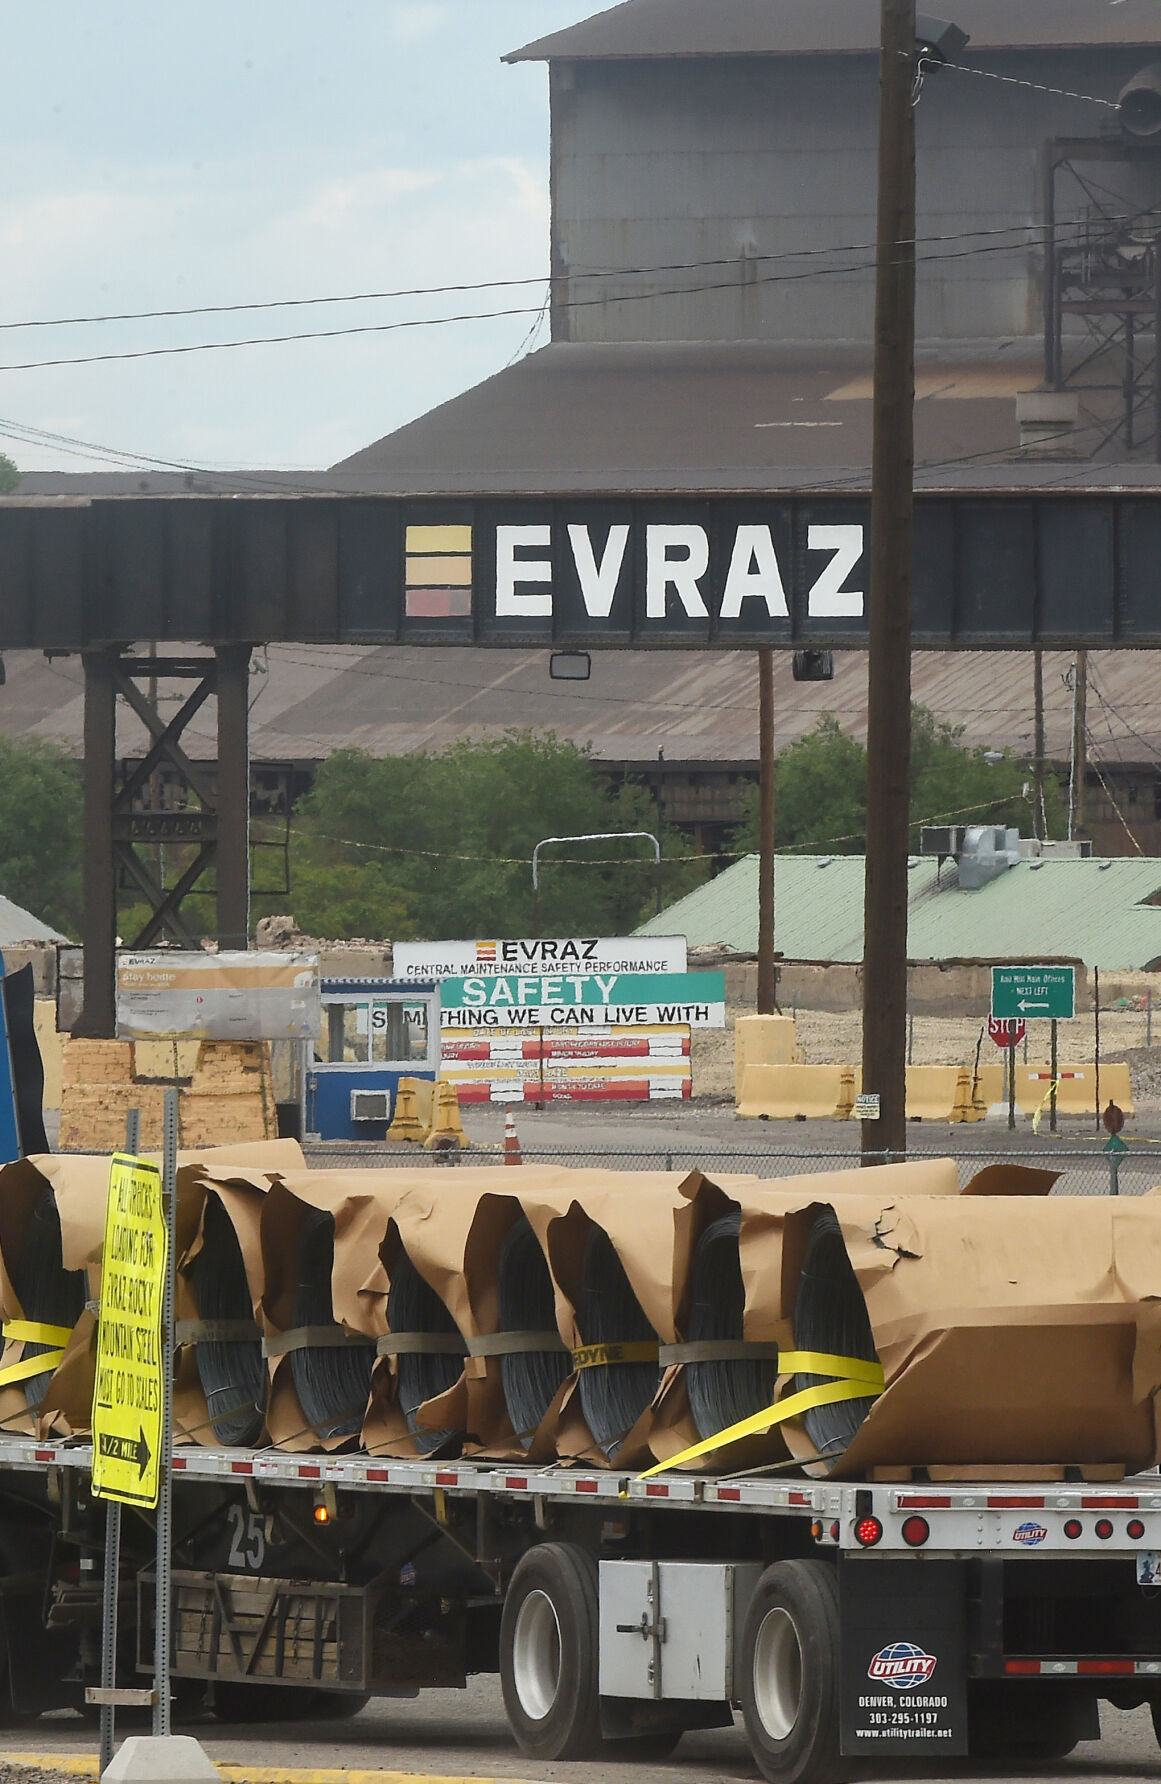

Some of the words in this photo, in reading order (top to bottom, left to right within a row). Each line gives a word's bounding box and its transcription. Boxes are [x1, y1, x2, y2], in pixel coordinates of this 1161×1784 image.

[495, 524, 864, 618] EVRAZ
[502, 940, 599, 961] EVRAZ
[406, 963, 458, 976] CENTRAL
[460, 962, 538, 975] MAINTENANCE
[541, 961, 581, 973] SAFETY
[585, 960, 668, 973] PERFORMANCE
[462, 976, 618, 1006] SAFETY
[1016, 986, 1032, 995] NEXT
[1034, 986, 1048, 995] LEFT
[507, 1008, 540, 1024] WE
[550, 1007, 594, 1024] CAN
[604, 1006, 648, 1023] LIVE
[657, 1005, 709, 1021] WITH
[129, 1179, 153, 1219] TRUCKS
[111, 1224, 139, 1266] LOADING
[139, 1231, 154, 1268] FOR
[128, 1277, 155, 1317] ROCKY
[101, 1319, 134, 1360] MOUNTAIN
[135, 1326, 157, 1366] STEEL
[98, 1367, 114, 1403] MUST
[115, 1370, 125, 1404] GO
[126, 1373, 135, 1407] TO
[135, 1375, 158, 1412] SCALES
[102, 1434, 118, 1456] 1/2
[121, 1441, 138, 1460] MILE
[1014, 1529, 1046, 1540] UTILITY
[873, 1659, 933, 1675] UTILITY
[859, 1696, 897, 1708] DENVER,
[899, 1696, 948, 1707] COLORADO
[869, 1712, 938, 1724] 303-295-1197
[855, 1727, 952, 1740] www.utilitytrailer.net
